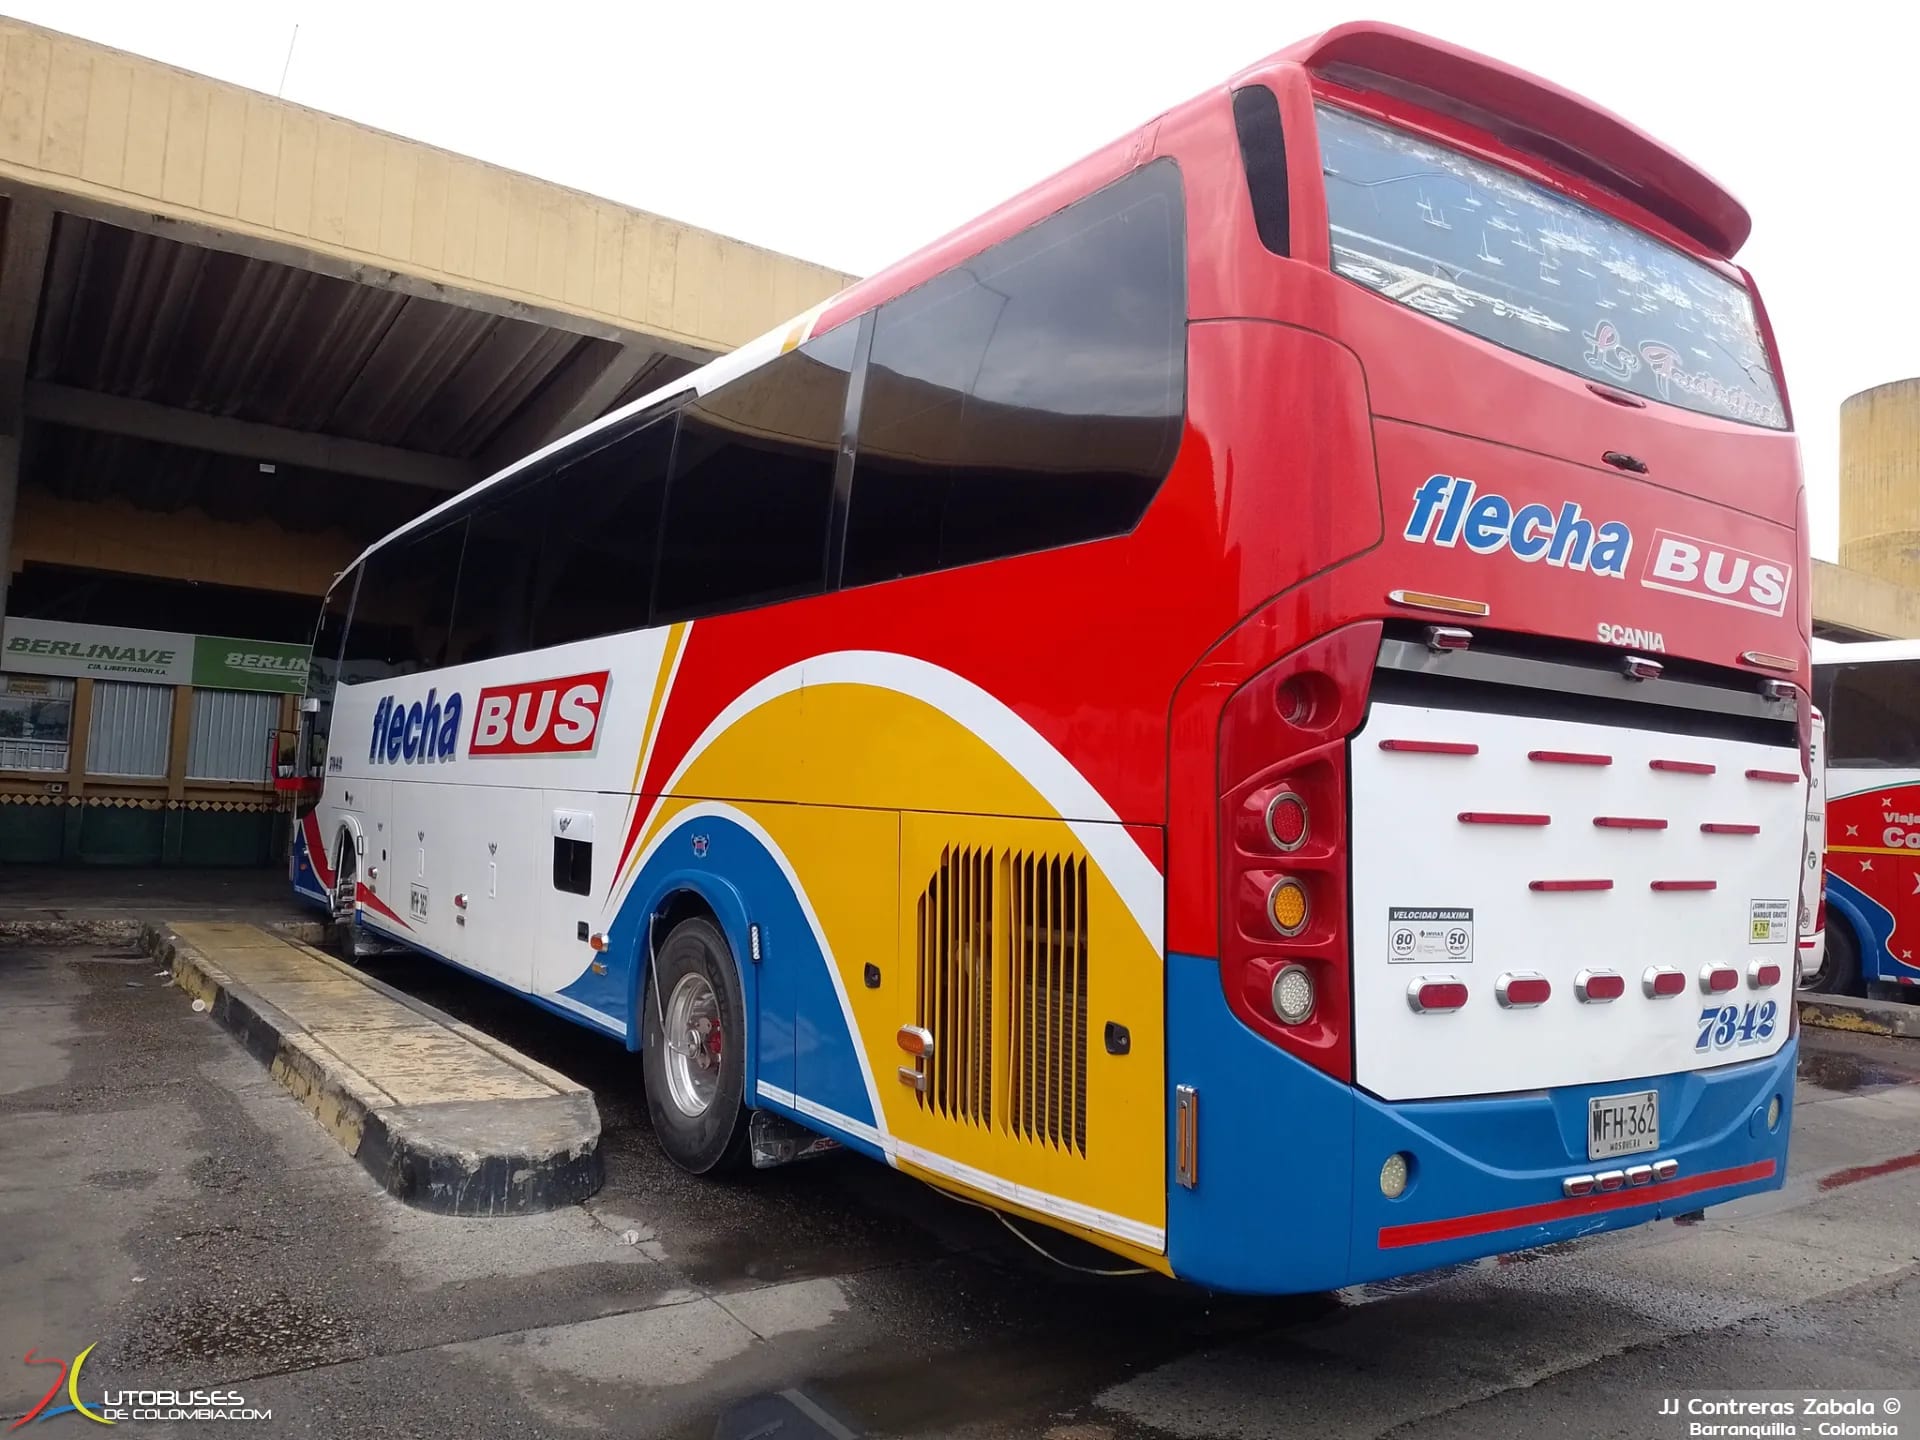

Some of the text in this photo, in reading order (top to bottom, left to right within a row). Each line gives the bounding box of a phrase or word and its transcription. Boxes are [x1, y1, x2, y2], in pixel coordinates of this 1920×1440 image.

[1403, 474, 1784, 606] flecha BUS
[6, 636, 176, 665] BERLINAVE
[1597, 622, 1666, 653] SCANIA
[368, 684, 600, 764] flecha BUS
[1393, 911, 1470, 920] VELOCIDAD MAXIMA
[1396, 933, 1413, 945] 80
[1449, 933, 1466, 945] 50
[1694, 1000, 1777, 1052] 7342
